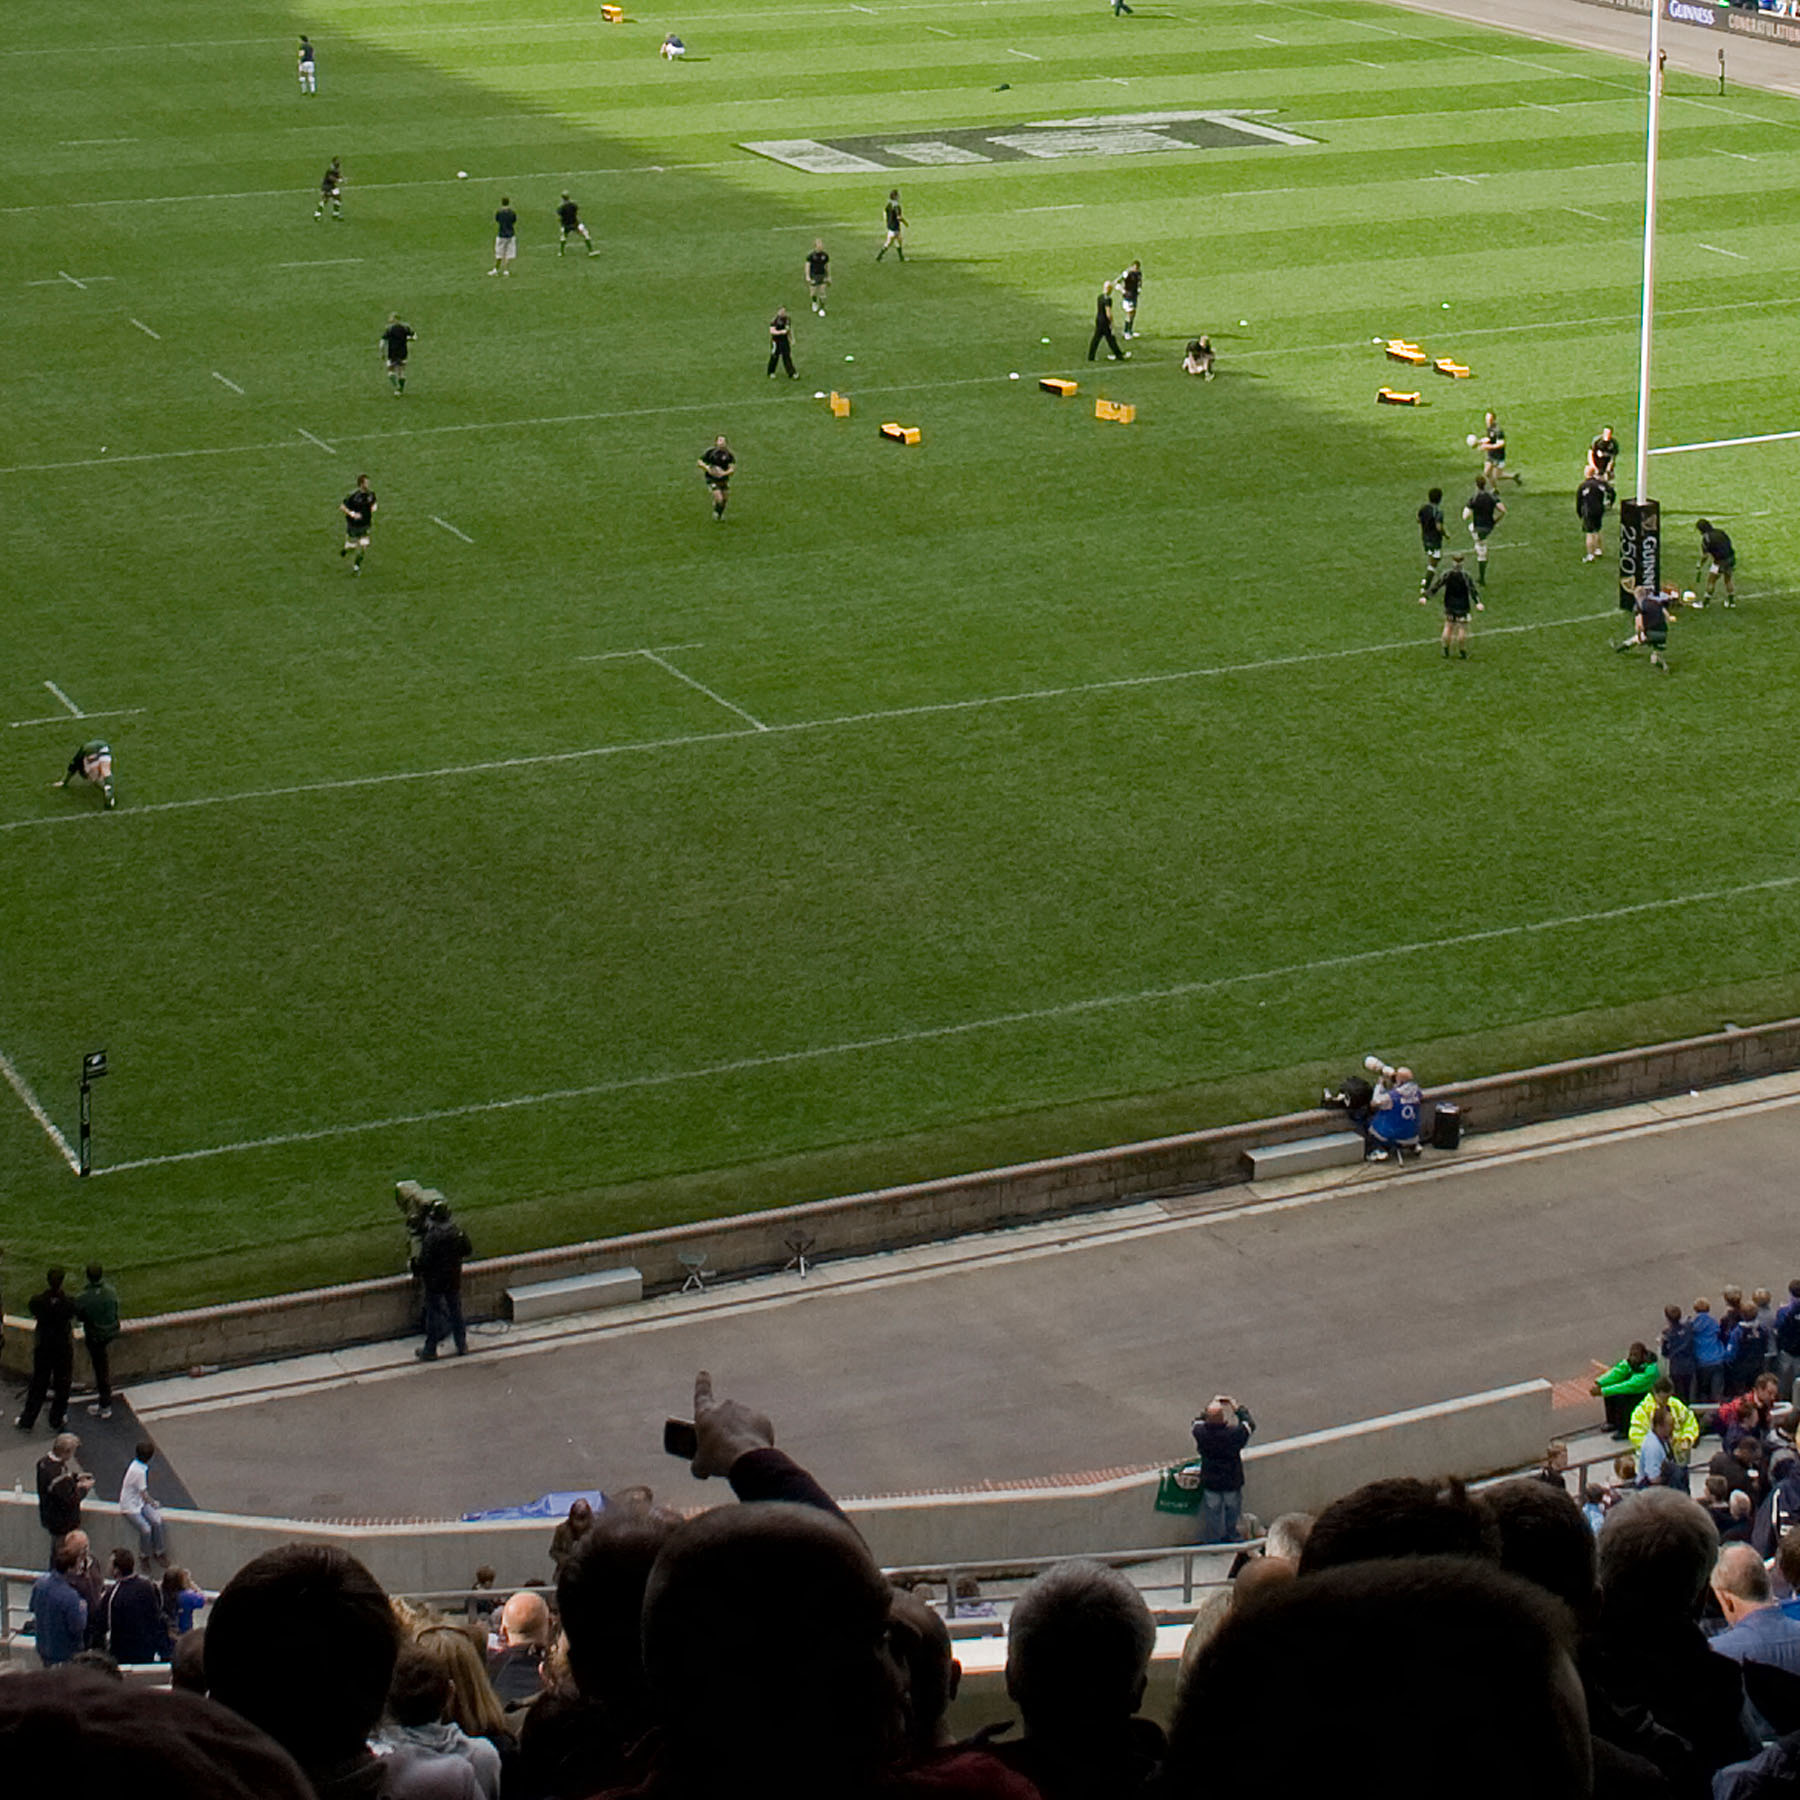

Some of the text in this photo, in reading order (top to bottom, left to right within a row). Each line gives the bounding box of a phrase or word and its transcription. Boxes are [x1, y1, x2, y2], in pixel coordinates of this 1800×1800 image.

[1669, 0, 1716, 26] GUINNESS
[1620, 523, 1637, 574] 250
[1642, 535, 1658, 591] GUINN
